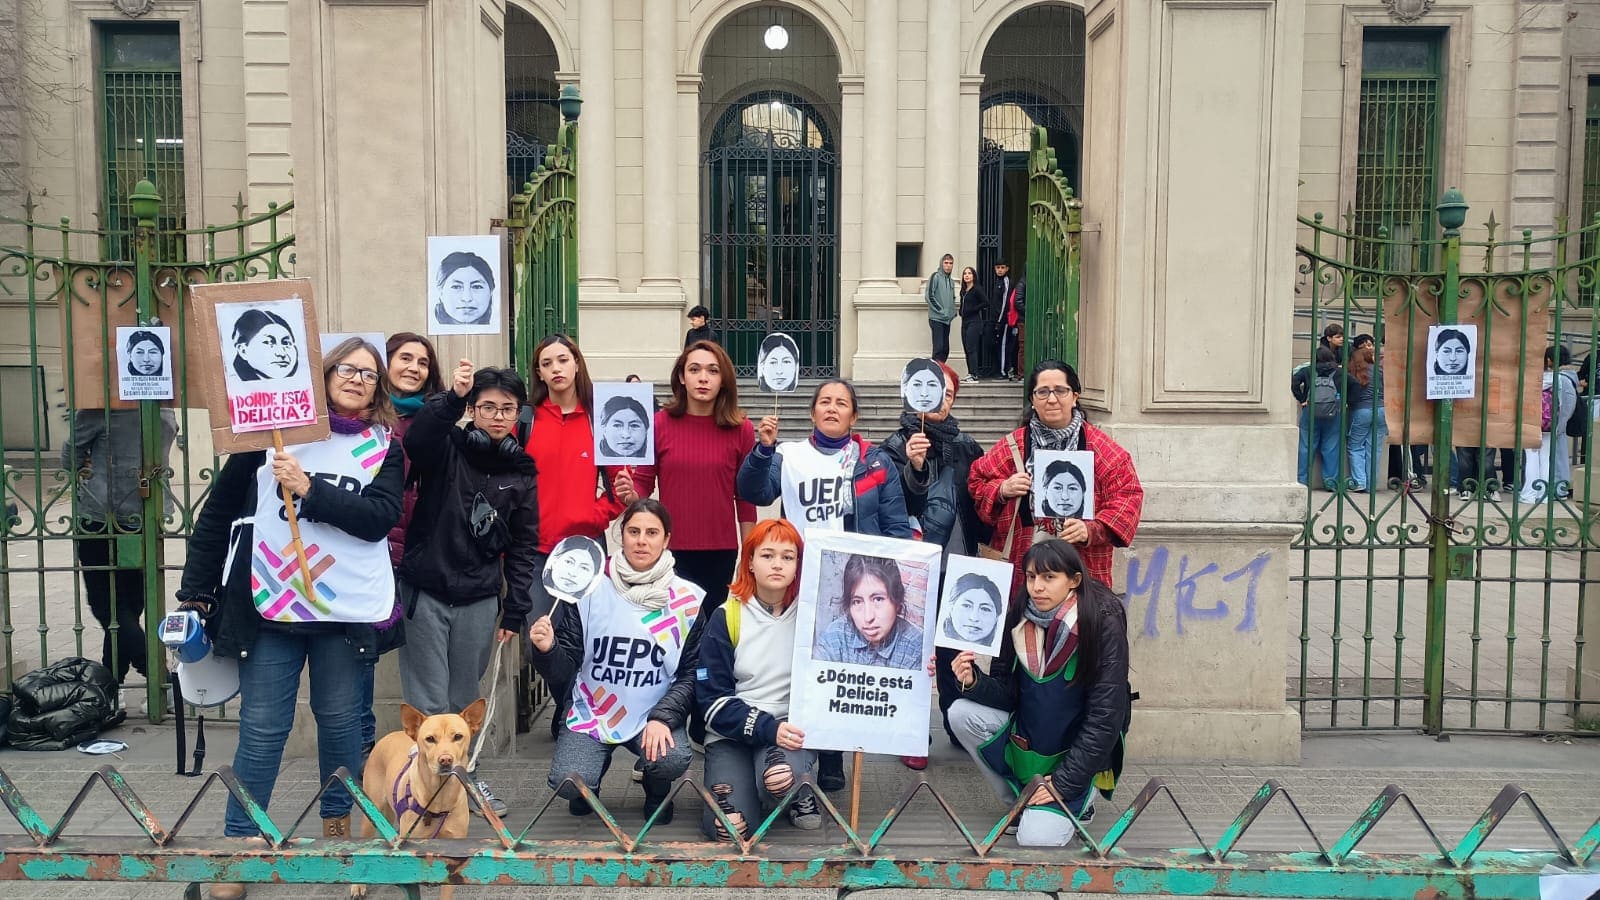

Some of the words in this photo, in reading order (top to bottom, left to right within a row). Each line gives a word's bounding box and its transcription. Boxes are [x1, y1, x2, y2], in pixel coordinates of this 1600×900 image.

[238, 404, 311, 424] DELICIA?
[592, 636, 667, 669] UEPC
[591, 665, 662, 687] CAPITAL
[816, 668, 876, 686] ¿Dónde
[879, 675, 913, 690] está
[836, 685, 889, 702] Delicia
[828, 699, 898, 717] Mamani?
